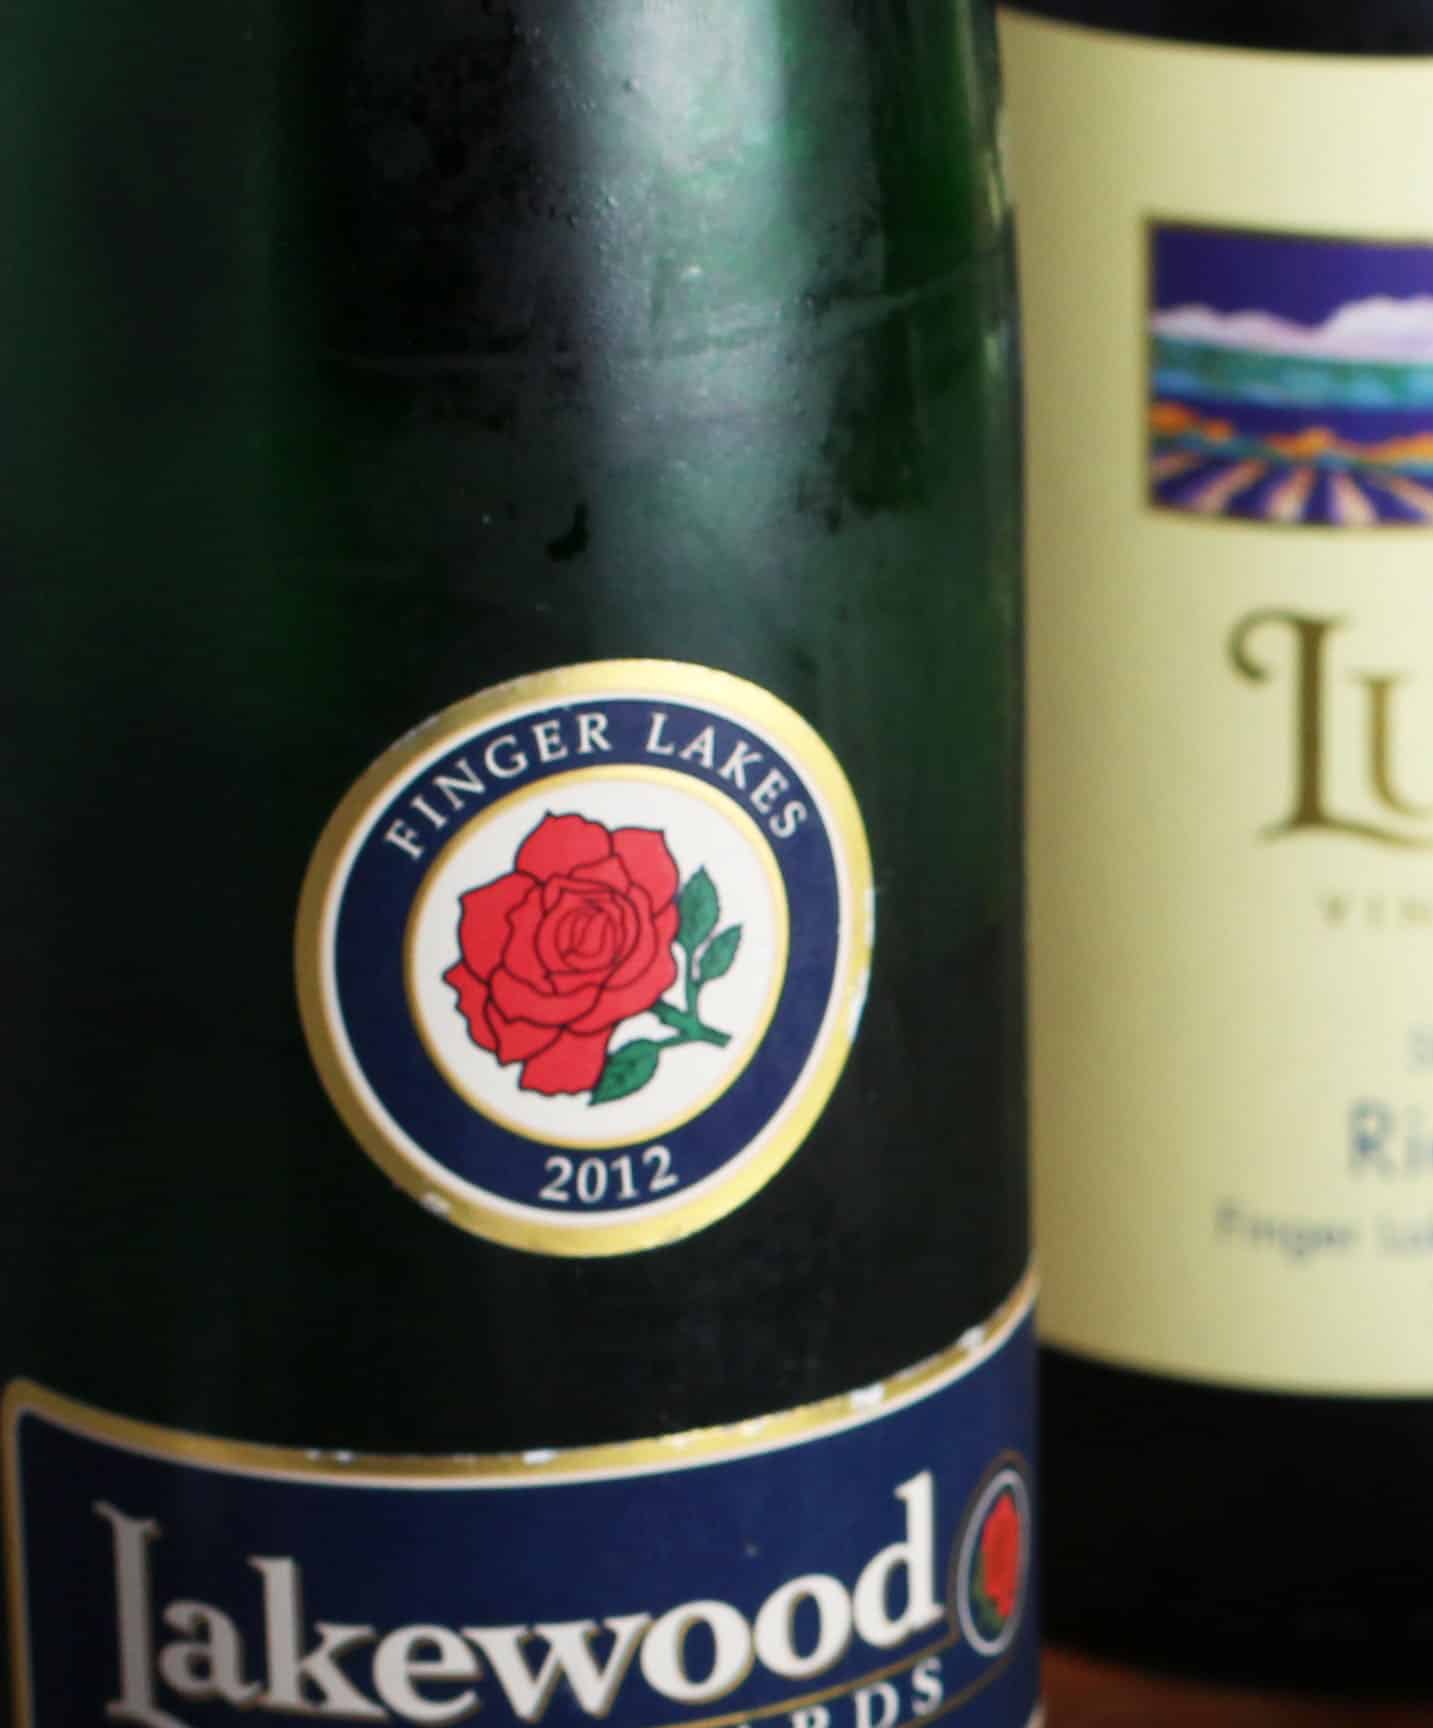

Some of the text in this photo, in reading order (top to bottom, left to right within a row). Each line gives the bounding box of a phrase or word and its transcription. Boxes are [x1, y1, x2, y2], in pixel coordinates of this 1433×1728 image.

[384, 711, 808, 861] FINGER LAKES
[538, 1145, 680, 1203] 2012
